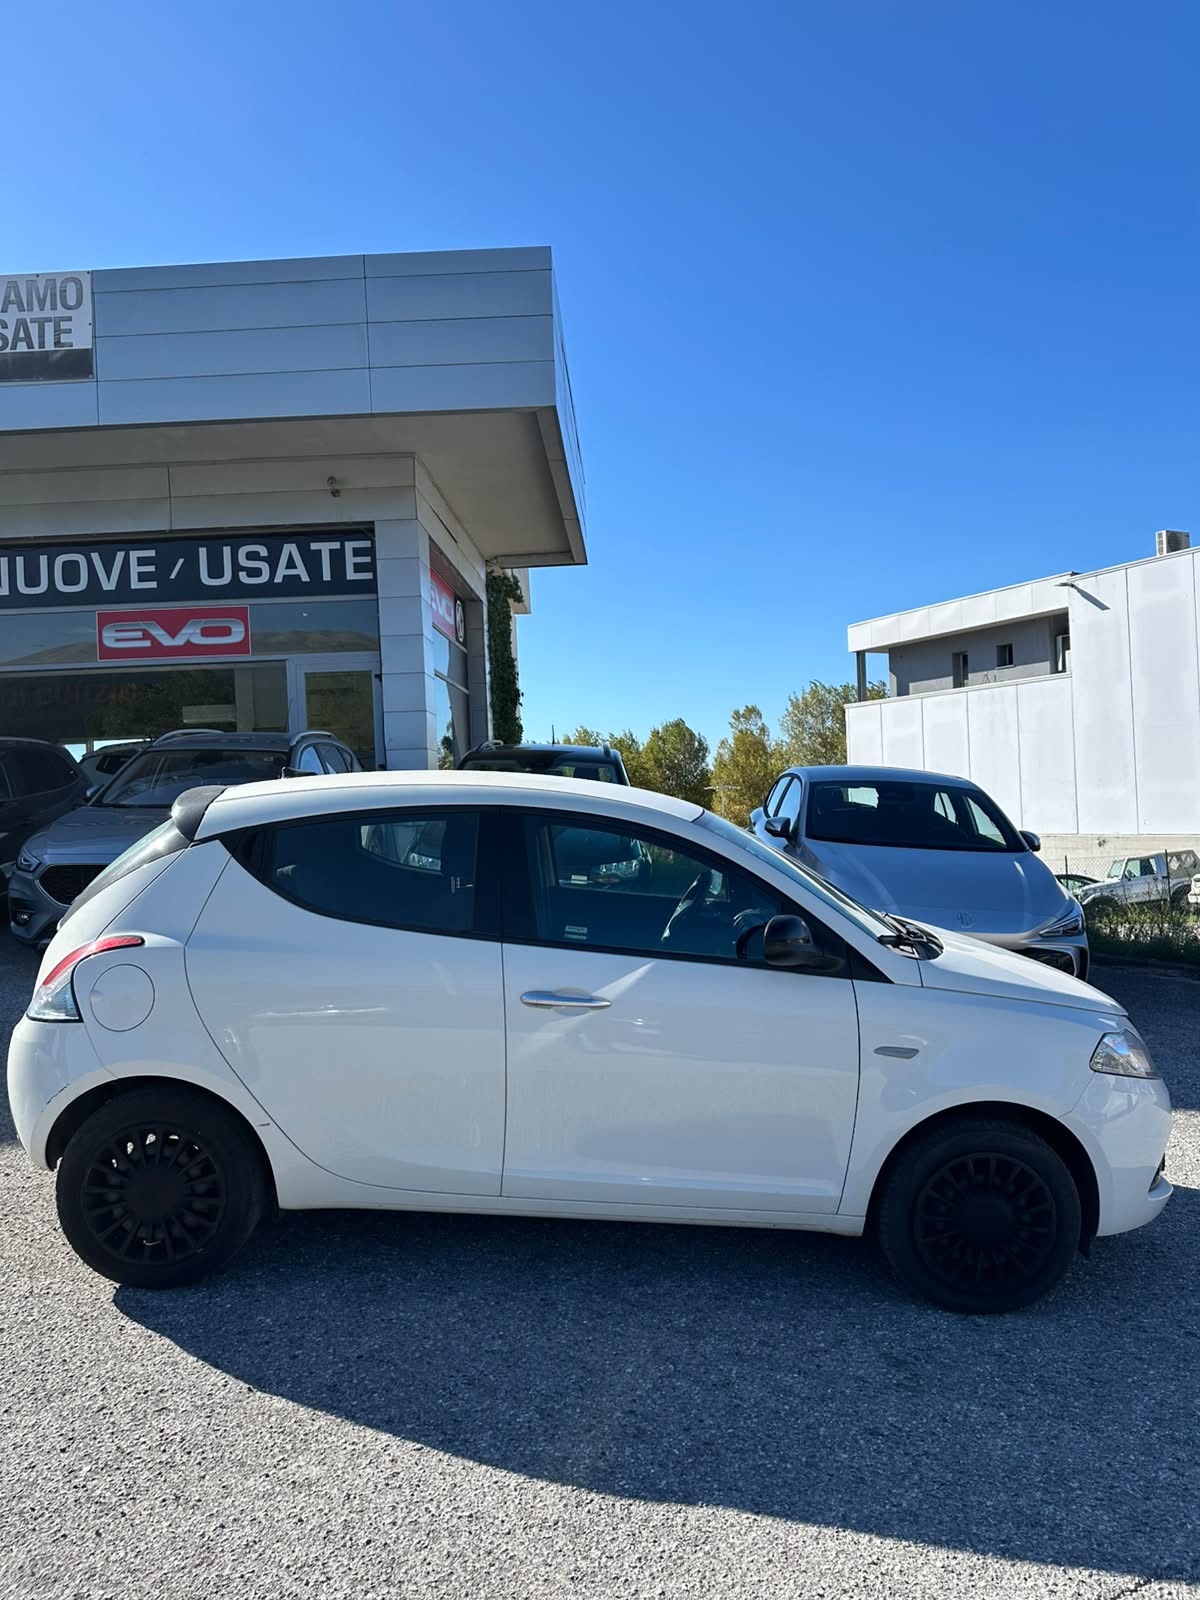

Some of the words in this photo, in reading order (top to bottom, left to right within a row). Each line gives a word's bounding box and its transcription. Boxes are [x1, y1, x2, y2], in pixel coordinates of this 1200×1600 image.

[1, 276, 84, 313] AMO
[0, 549, 158, 597] UOVE
[198, 540, 374, 586] USATE
[102, 618, 246, 649] EVO
